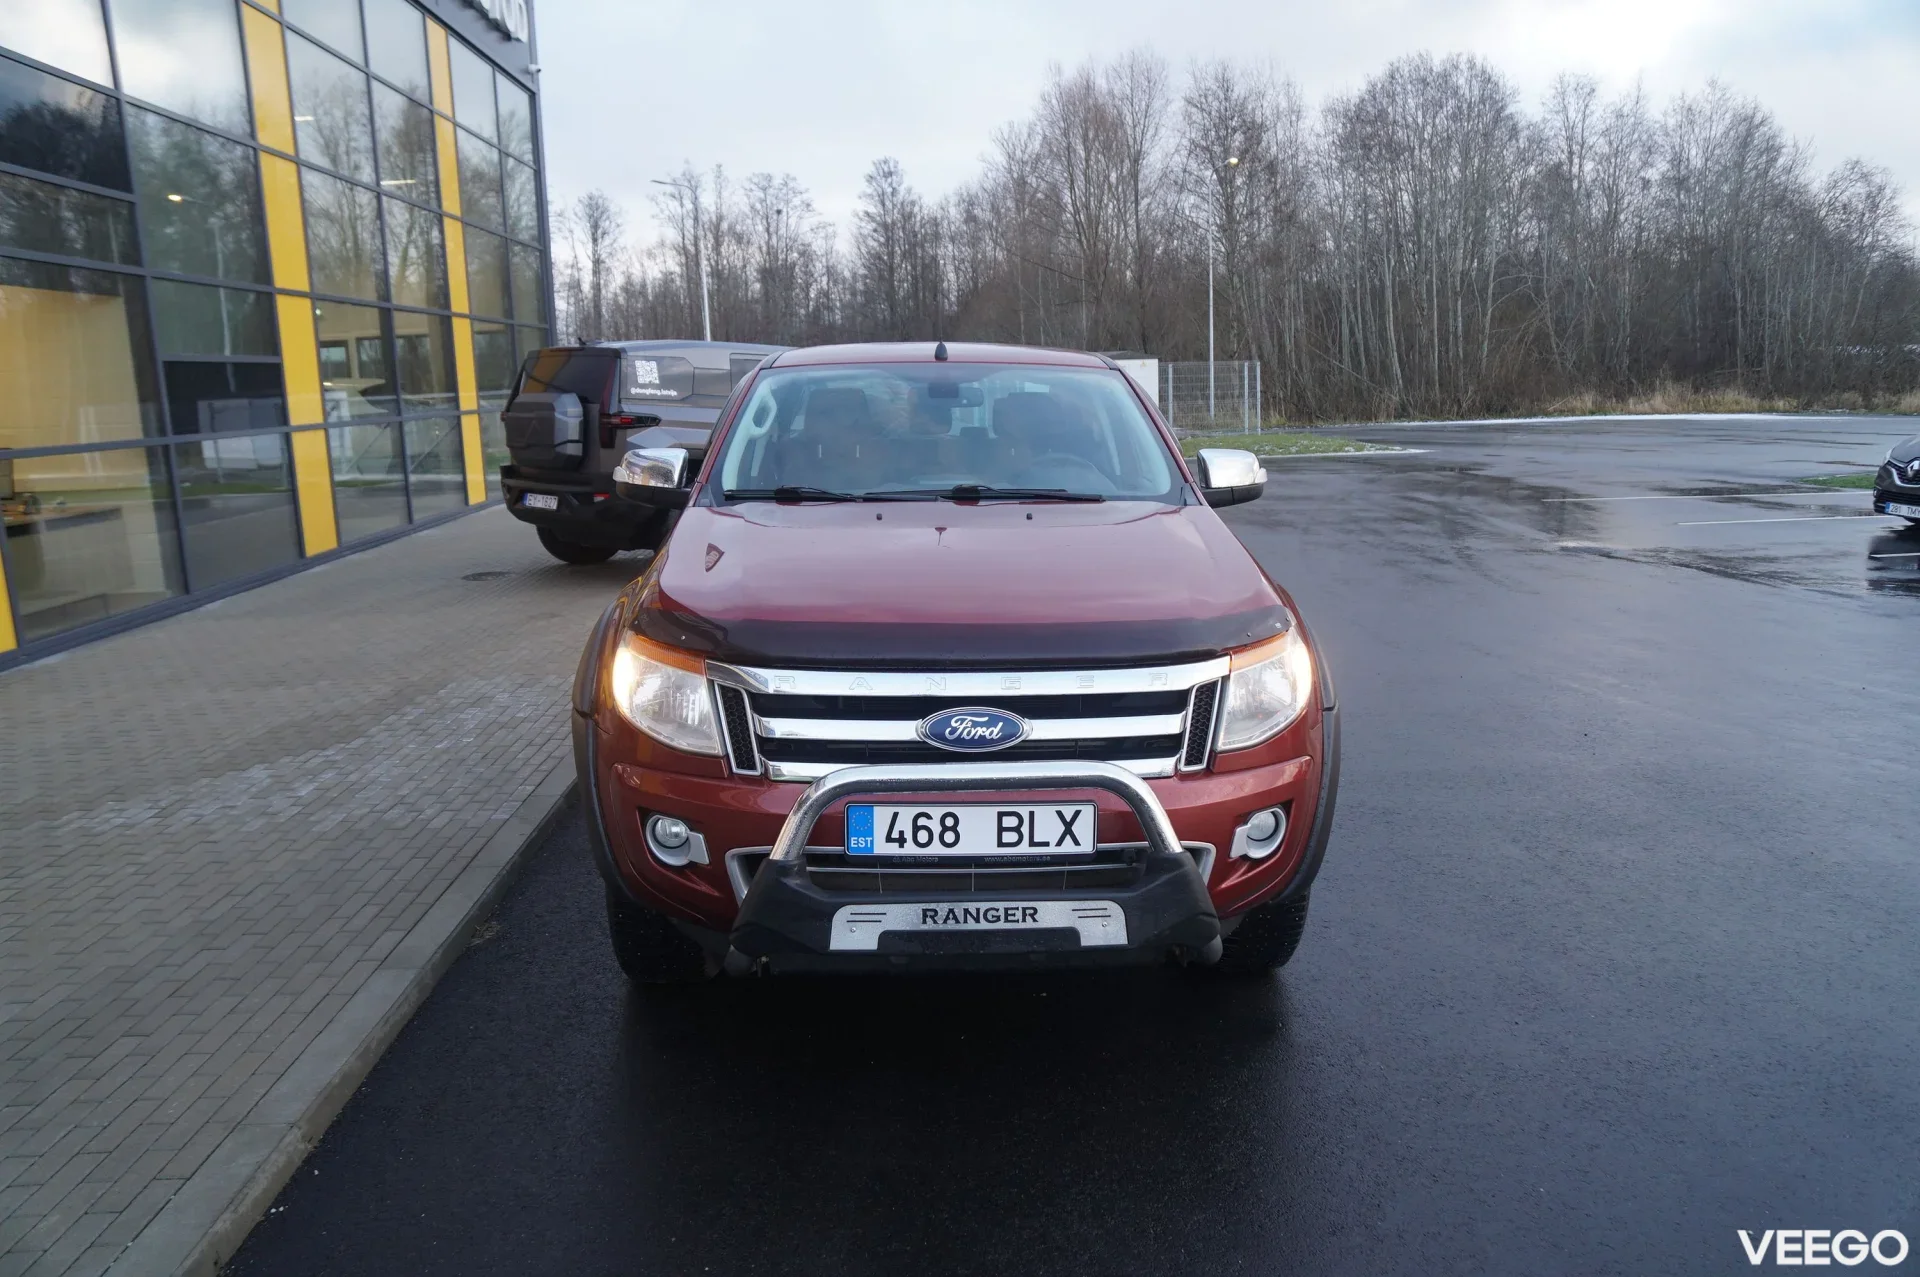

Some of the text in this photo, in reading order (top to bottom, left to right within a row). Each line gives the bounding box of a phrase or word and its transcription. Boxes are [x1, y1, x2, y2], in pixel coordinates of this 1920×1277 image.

[944, 716, 1003, 741] Ford
[885, 809, 1083, 849] 468 BLX
[850, 837, 873, 848] EST
[921, 906, 1039, 925] RANGER
